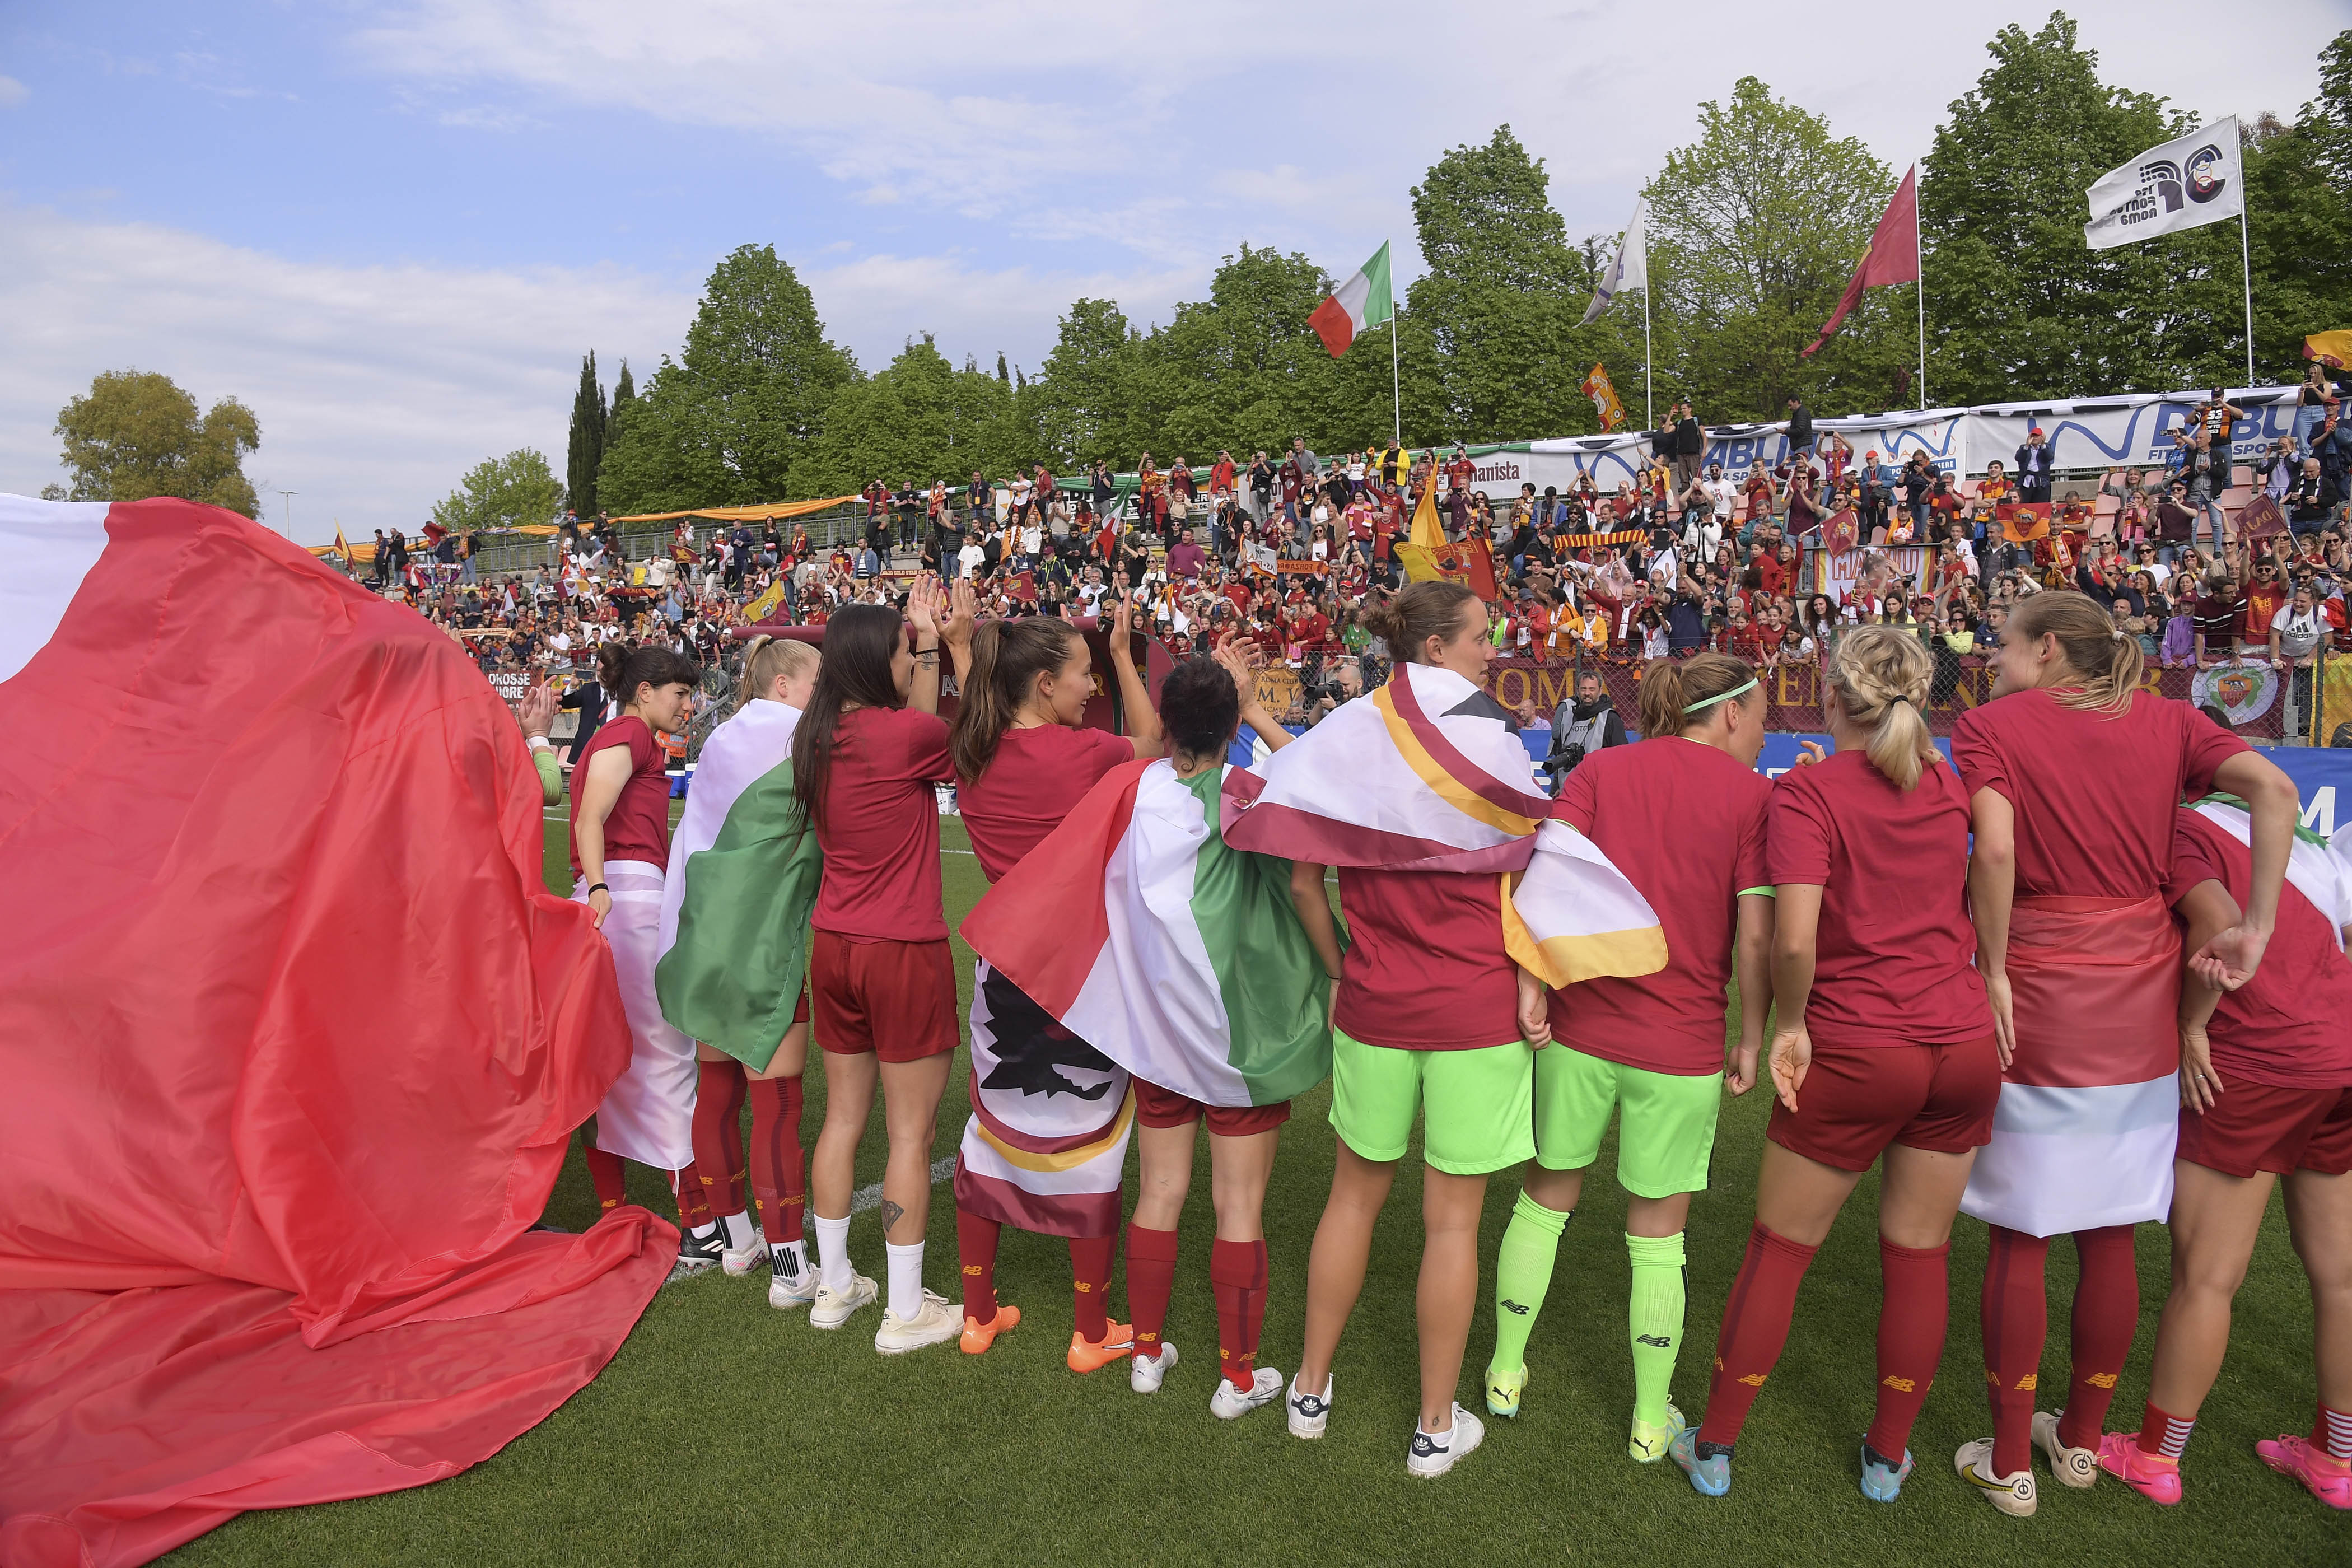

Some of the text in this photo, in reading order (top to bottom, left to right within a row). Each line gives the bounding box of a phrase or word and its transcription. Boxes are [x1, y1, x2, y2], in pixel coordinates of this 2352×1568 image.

[1702, 433, 1818, 470] ABLIU
[2148, 449, 2173, 460] FIT
[2233, 442, 2267, 455] SPO
[1733, 470, 1775, 482] SPT
[2286, 630, 2313, 639] adidas
[488, 673, 530, 685] OROSSE
[496, 686, 524, 699] UORE
